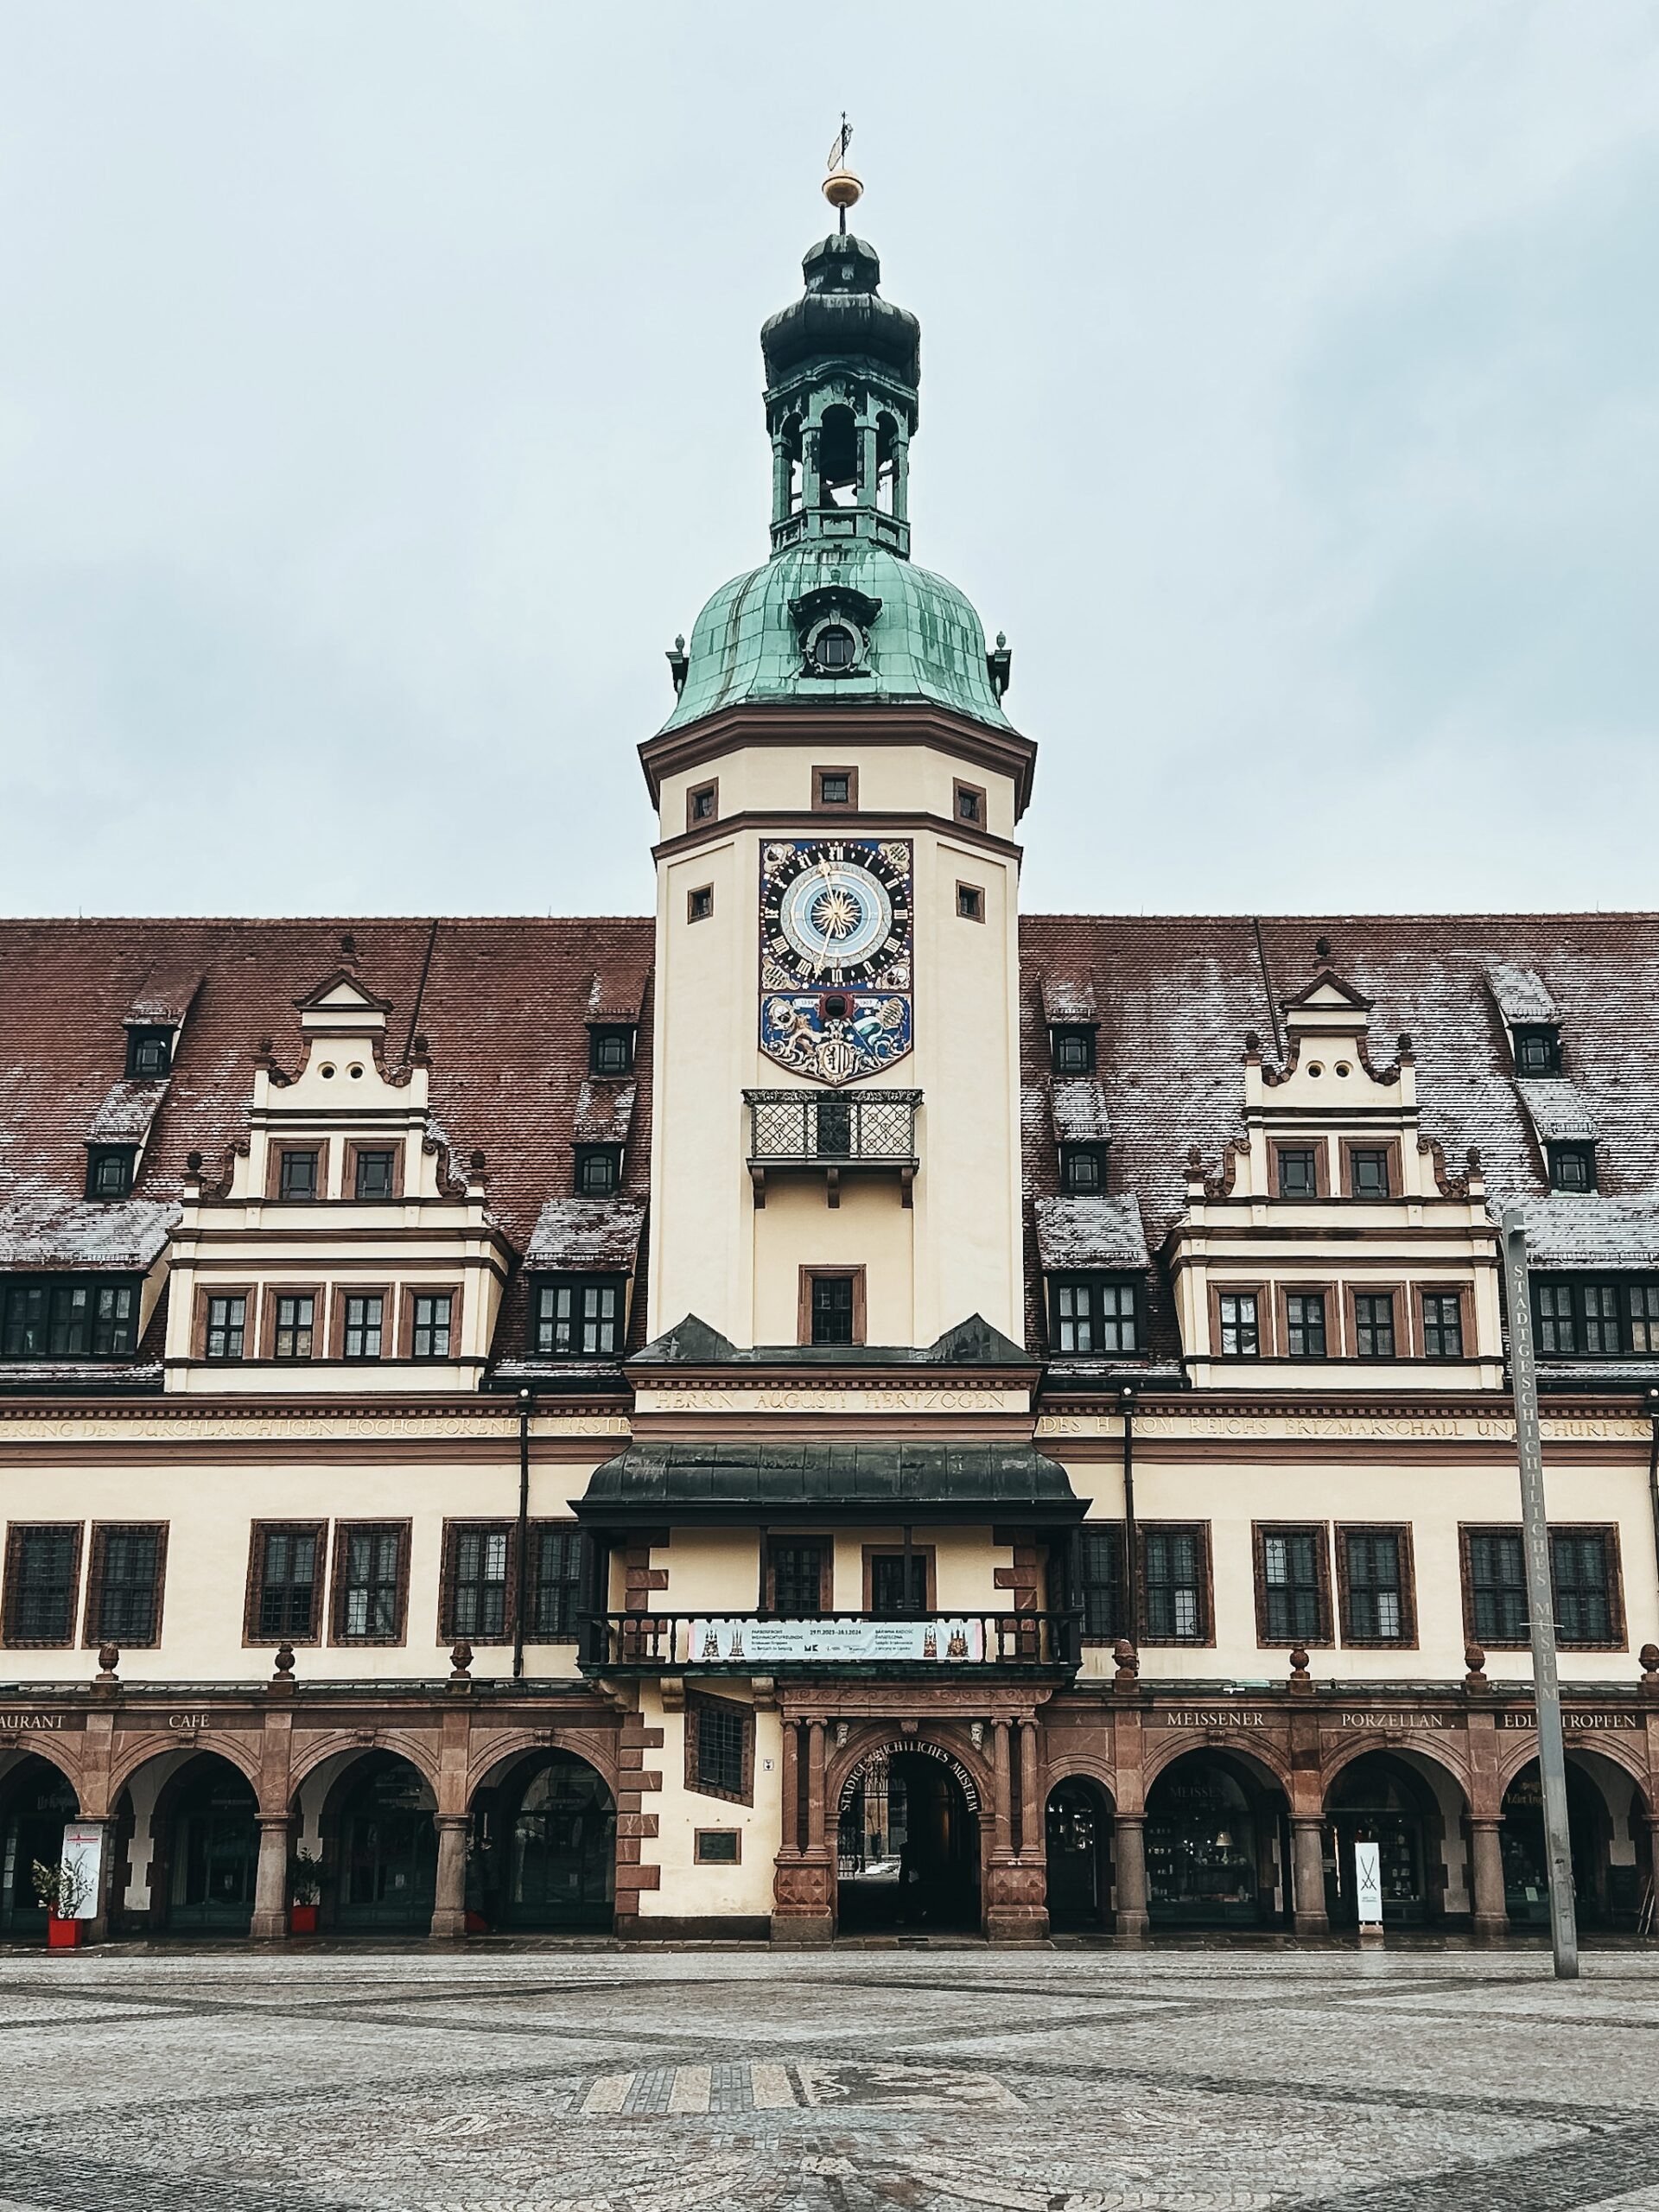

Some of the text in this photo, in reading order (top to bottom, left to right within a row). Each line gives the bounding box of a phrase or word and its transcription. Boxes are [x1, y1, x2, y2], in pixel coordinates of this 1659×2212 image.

[655, 1391, 734, 1408] HERRN
[864, 1391, 1006, 1408] HERTZOGEN
[82, 1421, 118, 1438] DES
[130, 1420, 334, 1437] DURCHLAUCHTIGEN
[1041, 1417, 1082, 1433] DES
[1189, 1418, 1268, 1434] REICHS
[1285, 1419, 1465, 1436] ERTZMARSCHALL
[1476, 1420, 1516, 1436] UN
[1513, 1264, 1558, 1701] STADTGESCHICHTLICHES MUSEUM
[1166, 1712, 1265, 1726] MEISSENER
[1342, 1713, 1444, 1727] PORZELLAN
[1503, 1713, 1637, 1728] EDL TROPFEN
[949, 1761, 979, 1813] MUSEUM
